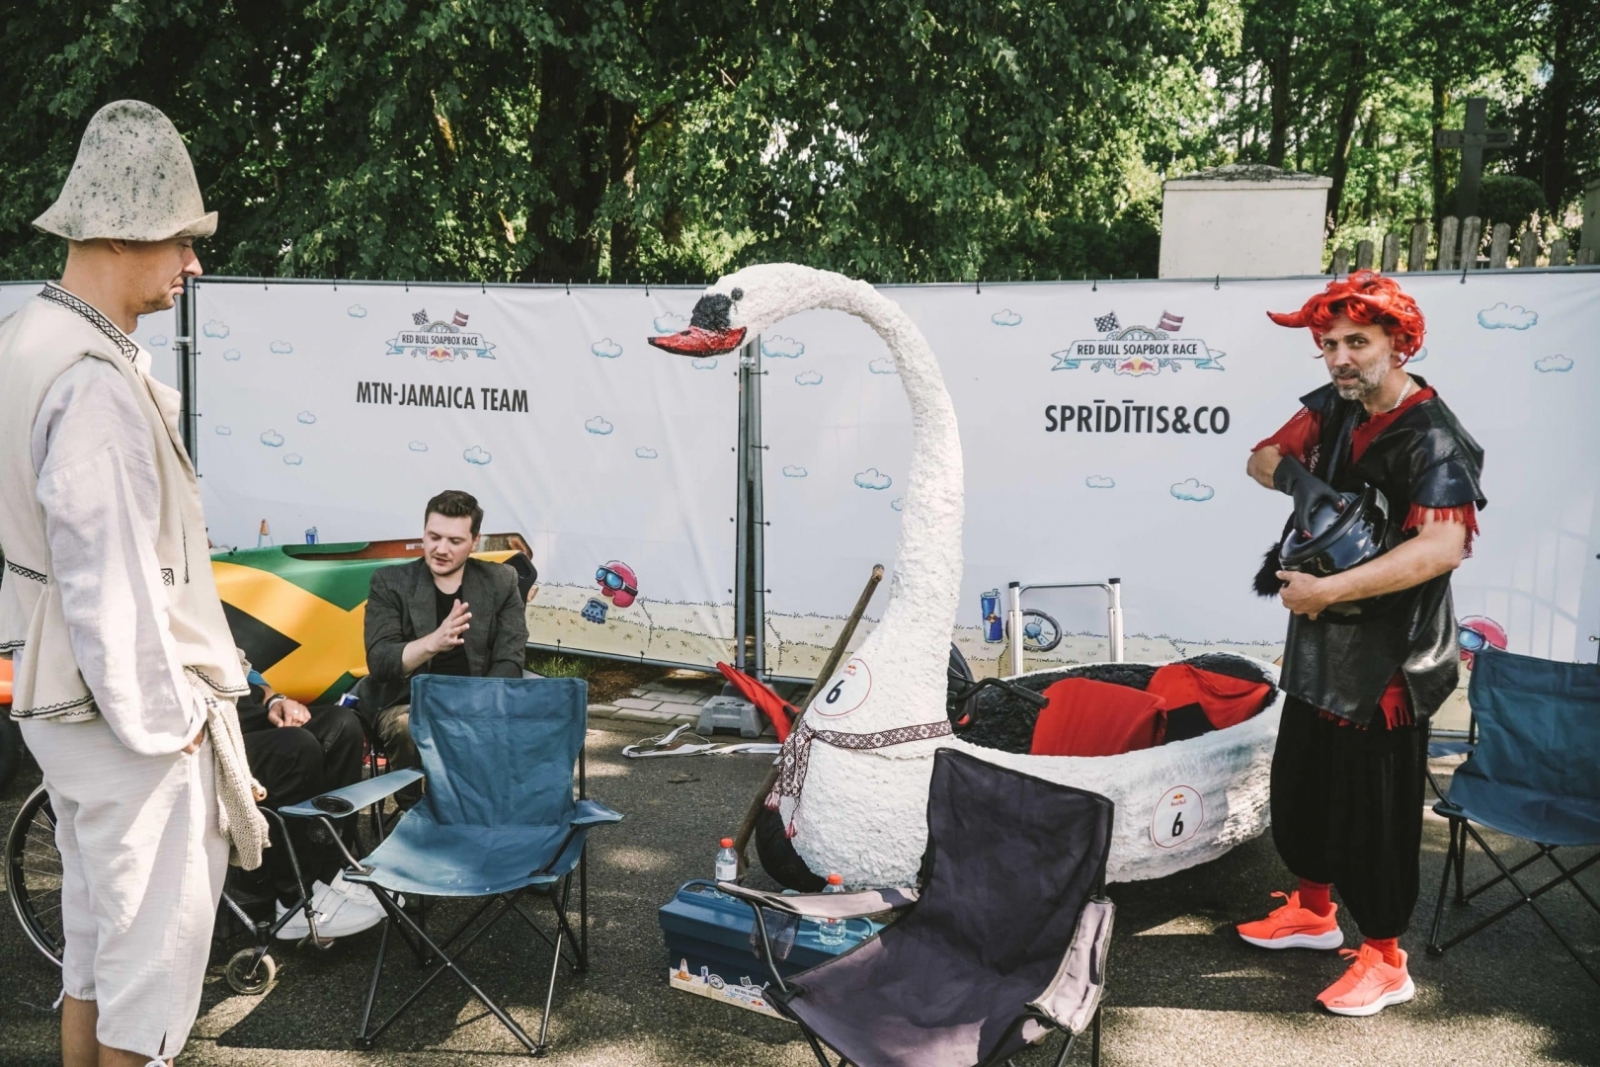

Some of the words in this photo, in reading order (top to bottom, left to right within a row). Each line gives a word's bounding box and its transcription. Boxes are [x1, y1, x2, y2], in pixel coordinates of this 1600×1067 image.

[402, 334, 414, 344] RED
[415, 335, 430, 344] BULL
[431, 335, 461, 345] SOAPBOX
[462, 336, 478, 346] RACE
[1077, 344, 1095, 355] RED
[1096, 344, 1120, 355] BULL
[1123, 344, 1169, 355] SOAPBOX
[1172, 343, 1198, 355] RACE
[356, 381, 476, 410] MTN-JAMAICA
[481, 388, 529, 413] TEAM
[1045, 399, 1230, 434] SPRĪDĪTIS&CO
[825, 679, 845, 704] 6
[1171, 811, 1184, 837] 6
